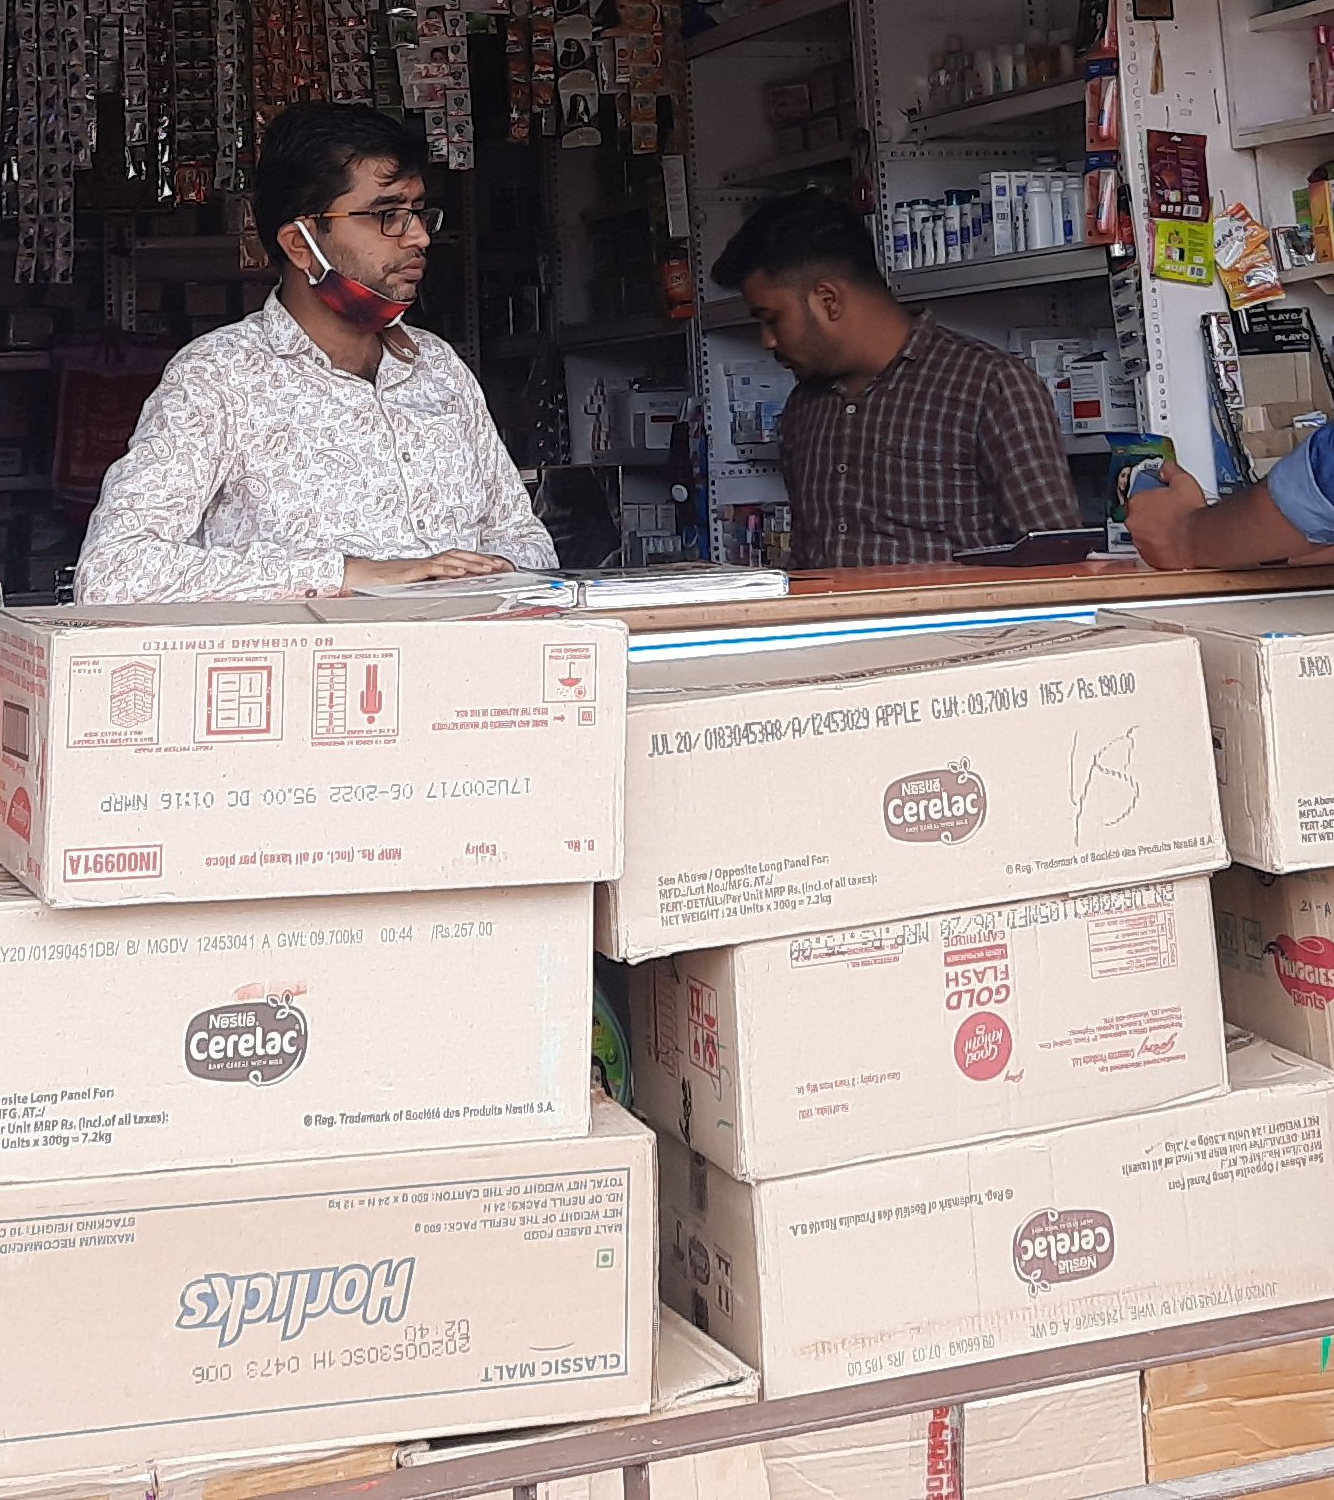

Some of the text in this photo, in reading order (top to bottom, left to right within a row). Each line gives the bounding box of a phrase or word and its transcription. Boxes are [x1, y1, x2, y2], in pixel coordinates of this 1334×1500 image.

[875, 699, 921, 727] APPLE
[261, 786, 317, 805] 95.00
[329, 782, 413, 802] 06-2022
[887, 788, 979, 825] Cerelac
[261, 933, 269, 948] A
[945, 963, 1009, 989] FLASH
[945, 982, 1010, 1011] GOLD
[1291, 988, 1327, 1012] pants
[189, 1024, 297, 1061] Cerelac
[29, 1090, 57, 1105] Long
[59, 1086, 91, 1101] Panel
[1, 1136, 30, 1150] Units
[41, 1134, 69, 1149] 300g
[81, 1131, 111, 1145] 7.2kg
[521, 1181, 563, 1194] WEIGHT
[565, 1179, 587, 1191] NET
[589, 1176, 623, 1189] TOTAL
[431, 1188, 479, 1202] CARTON:
[483, 1186, 503, 1198] THE
[505, 1185, 519, 1196] OF
[328, 1197, 341, 1210] kg
[377, 1195, 390, 1207] 24
[549, 1195, 585, 1207] REFILL
[587, 1194, 603, 1204] OF
[605, 1192, 623, 1203] NO.
[493, 1202, 505, 1212] 24
[603, 1207, 622, 1218] NET
[479, 1216, 515, 1228] REFILL
[519, 1214, 537, 1226] THE
[541, 1213, 556, 1224] OF
[560, 1209, 599, 1222] WEIGHT
[76, 1217, 135, 1231] STACKING
[423, 1222, 441, 1233] 500
[444, 1219, 477, 1231] PACK:
[9, 1226, 23, 1237] 10
[523, 1223, 622, 1240] MALT BASED FOOD
[79, 1232, 135, 1248] MAXIMUM
[1019, 1225, 1110, 1266] Cerelac
[175, 1256, 417, 1348] Horlicks
[479, 1352, 621, 1383] CLASSIC MALT
